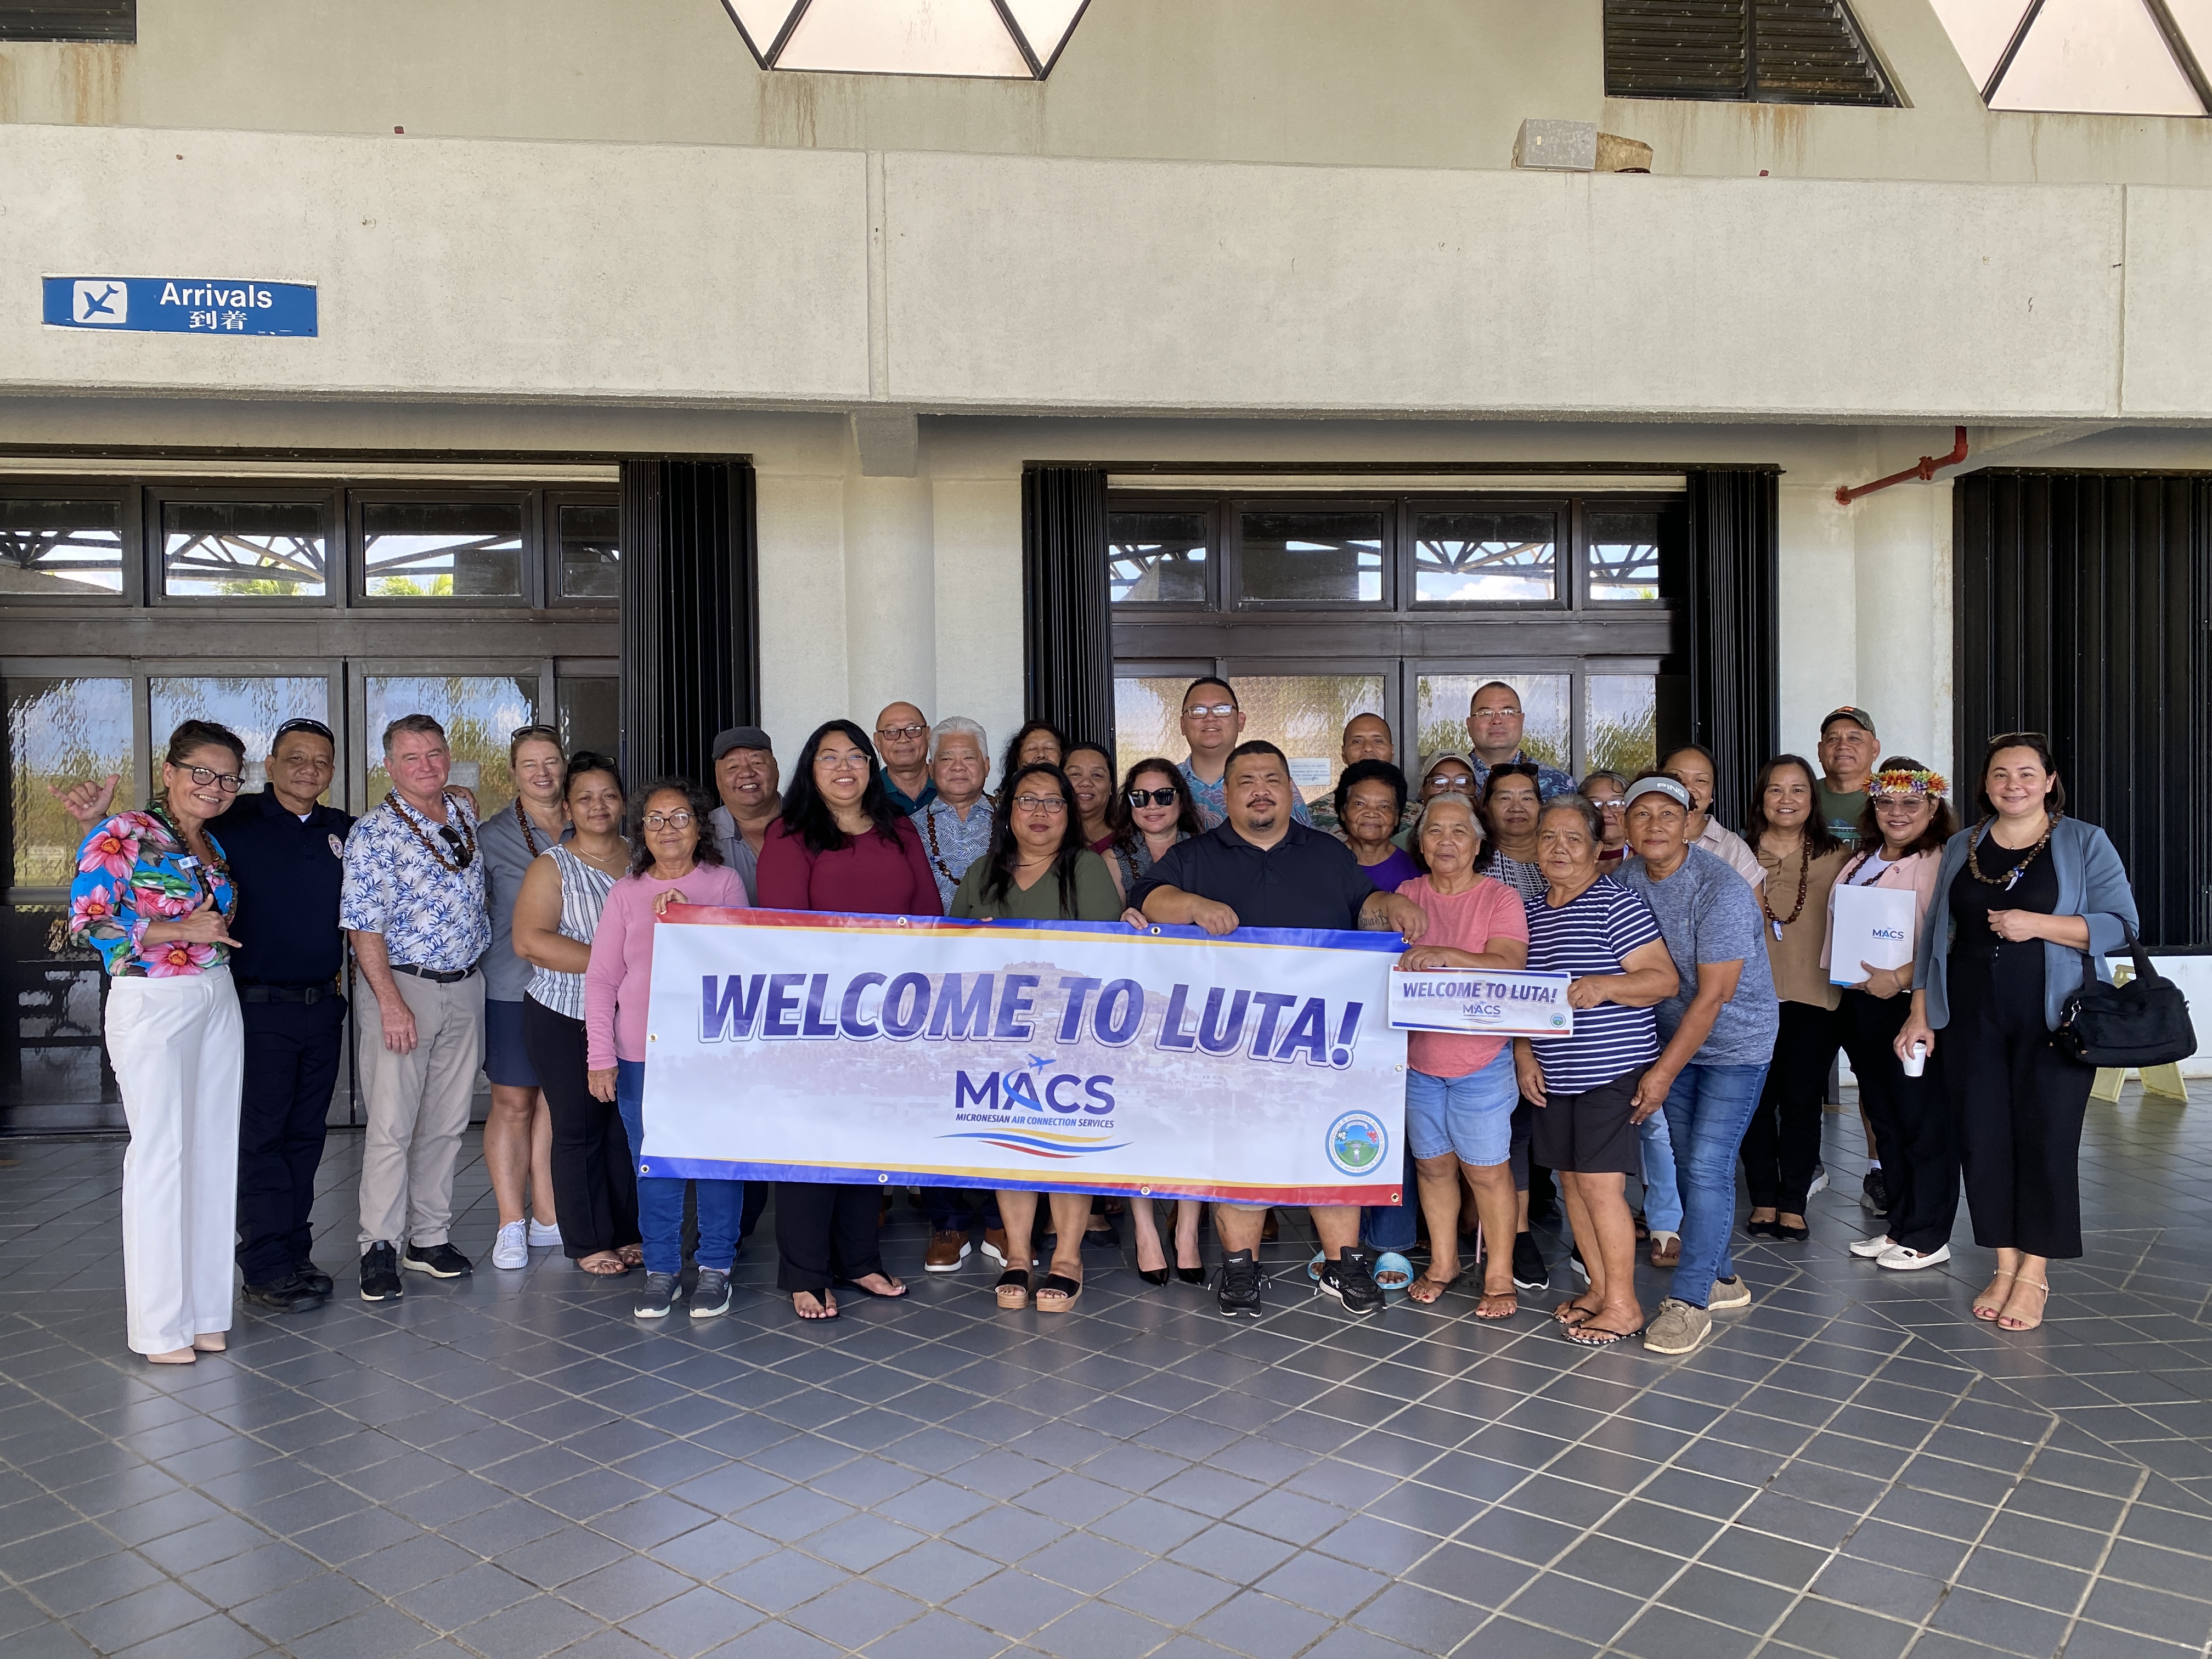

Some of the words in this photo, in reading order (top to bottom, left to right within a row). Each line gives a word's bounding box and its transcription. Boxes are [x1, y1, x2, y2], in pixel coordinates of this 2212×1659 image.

[159, 282, 273, 309] Arrivals
[189, 310, 248, 330] 到着
[1657, 783, 1685, 798] PING
[1872, 929, 1904, 939] MACS
[1403, 982, 1482, 998] WELCOME
[1485, 983, 1506, 999] TO
[1509, 984, 1558, 1004] LUTA!
[1463, 1004, 1501, 1014] MACS
[699, 972, 1041, 1042] WELCOME
[1054, 977, 1146, 1048] TO
[1154, 983, 1364, 1070] LUTA!
[955, 1070, 1115, 1115] MACS
[956, 1113, 1011, 1123] MICRONESIAN
[1026, 1116, 1076, 1126] CONNECTION
[1077, 1119, 1114, 1128] SERVICES
